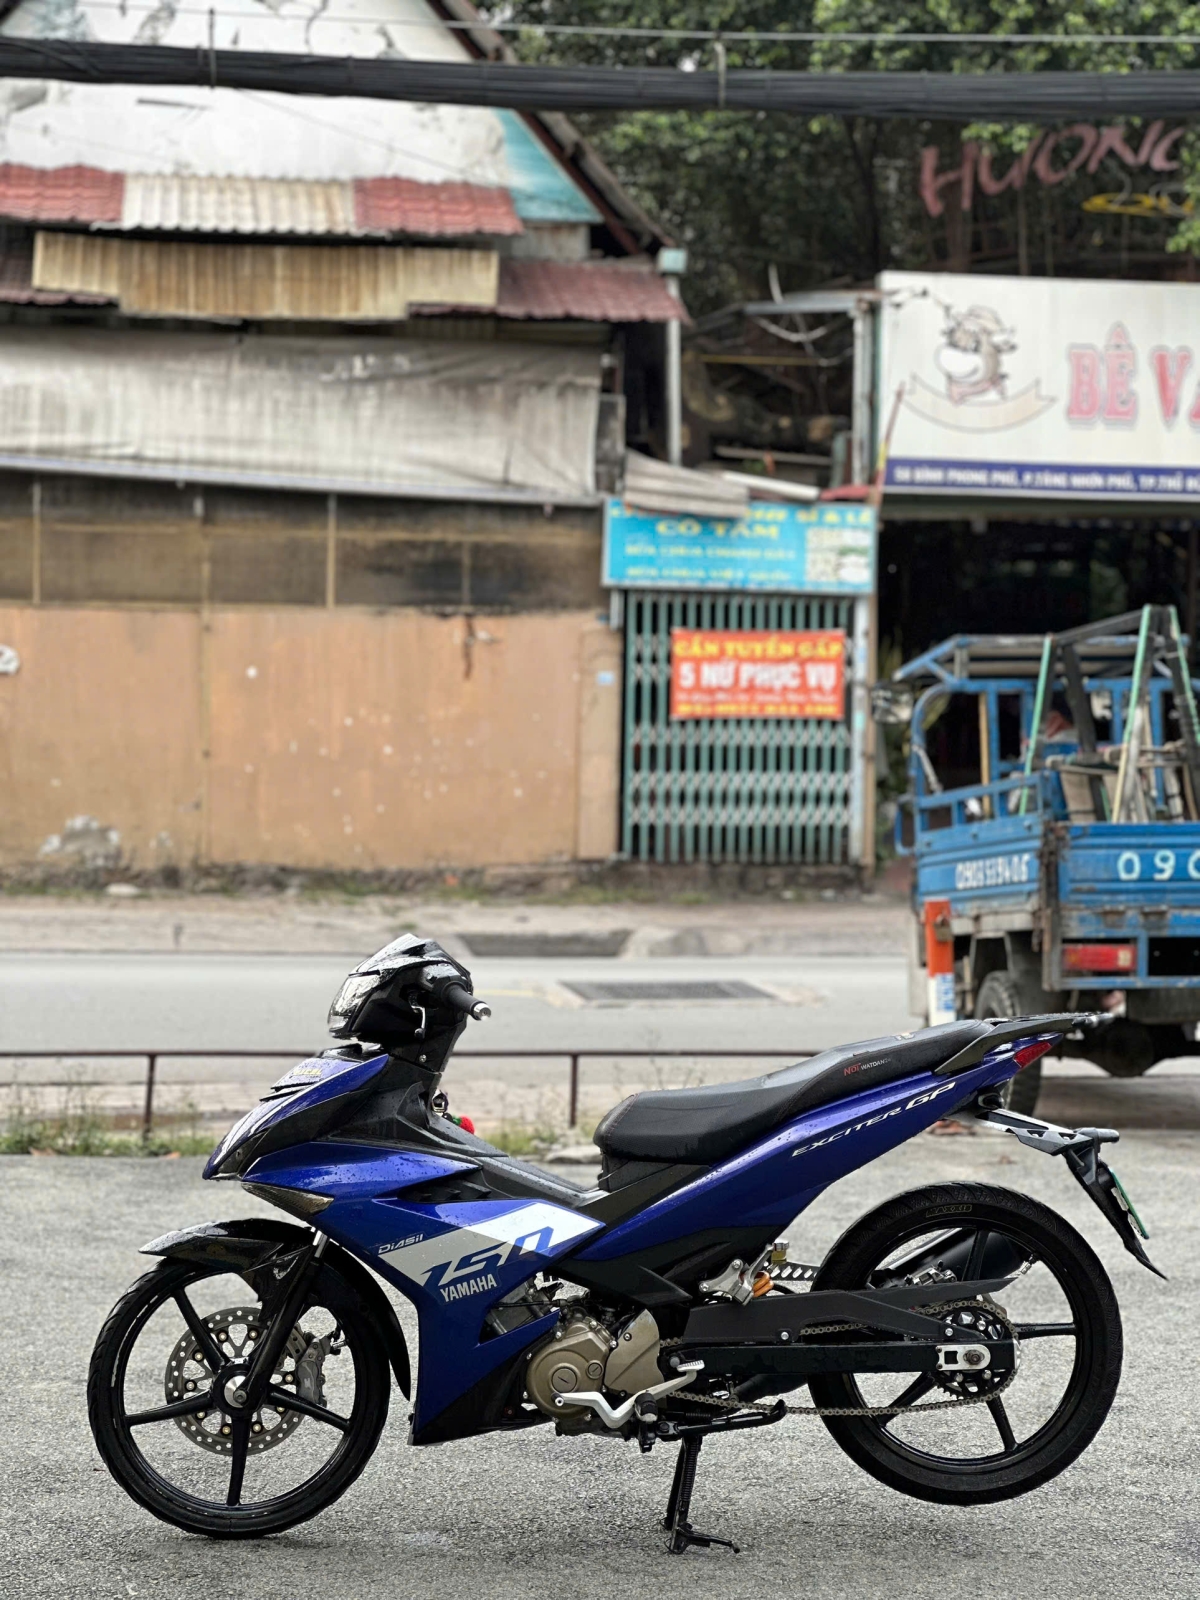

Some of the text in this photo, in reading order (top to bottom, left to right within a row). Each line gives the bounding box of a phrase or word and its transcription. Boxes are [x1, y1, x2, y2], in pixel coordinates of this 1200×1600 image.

[1065, 319, 1139, 430] BÊ
[680, 658, 837, 693] 5 NỮ PHỤC VỤ
[792, 1081, 956, 1157] EXCITER GP
[440, 1273, 498, 1303] YAMAHA
